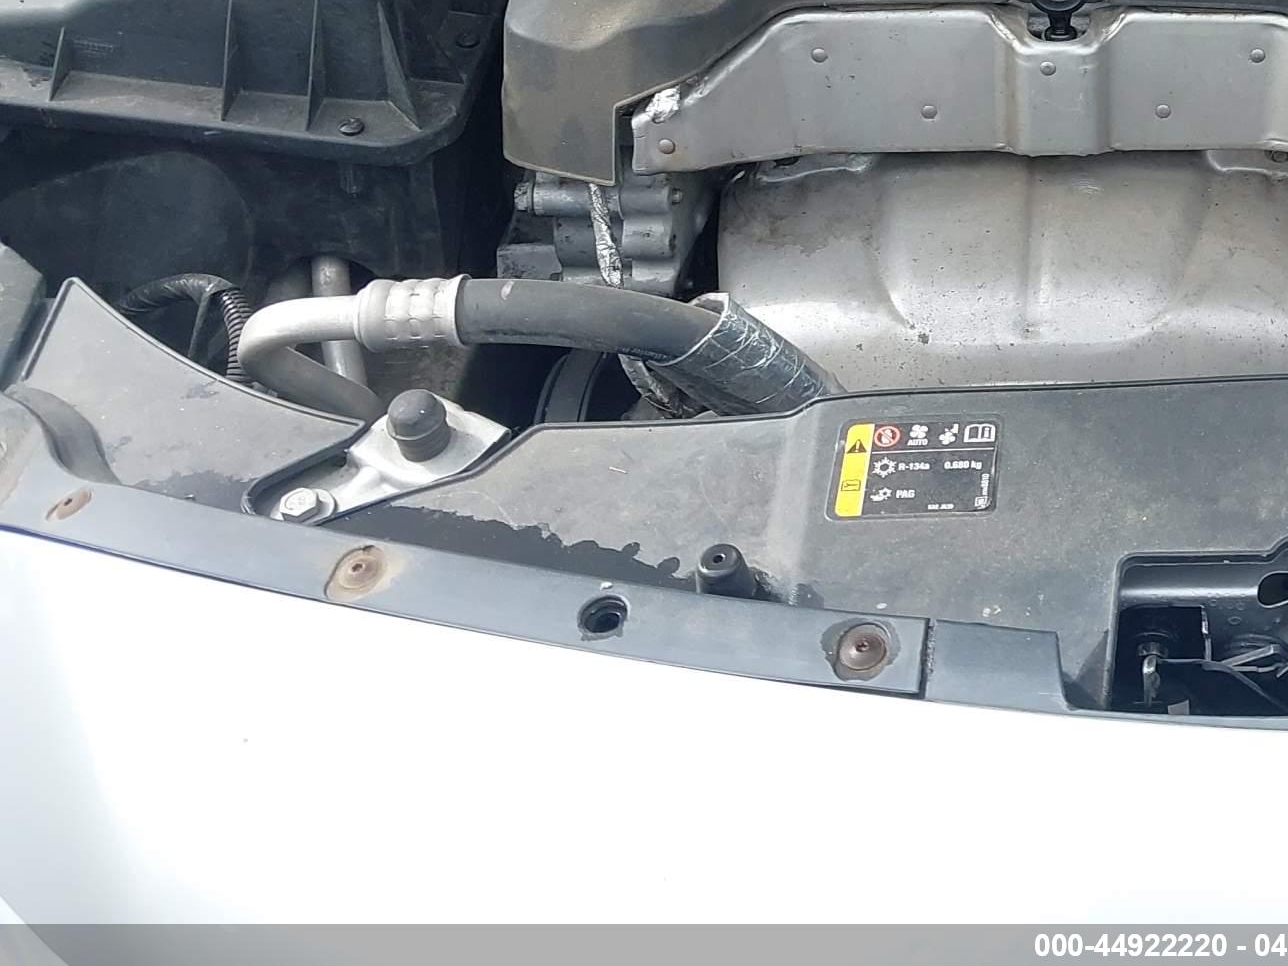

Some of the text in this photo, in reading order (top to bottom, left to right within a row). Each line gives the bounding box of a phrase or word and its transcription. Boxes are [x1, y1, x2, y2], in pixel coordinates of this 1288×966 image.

[907, 438, 929, 446] AUTO
[898, 460, 982, 470] R-134a 0.680 kg
[895, 489, 916, 499] PAG
